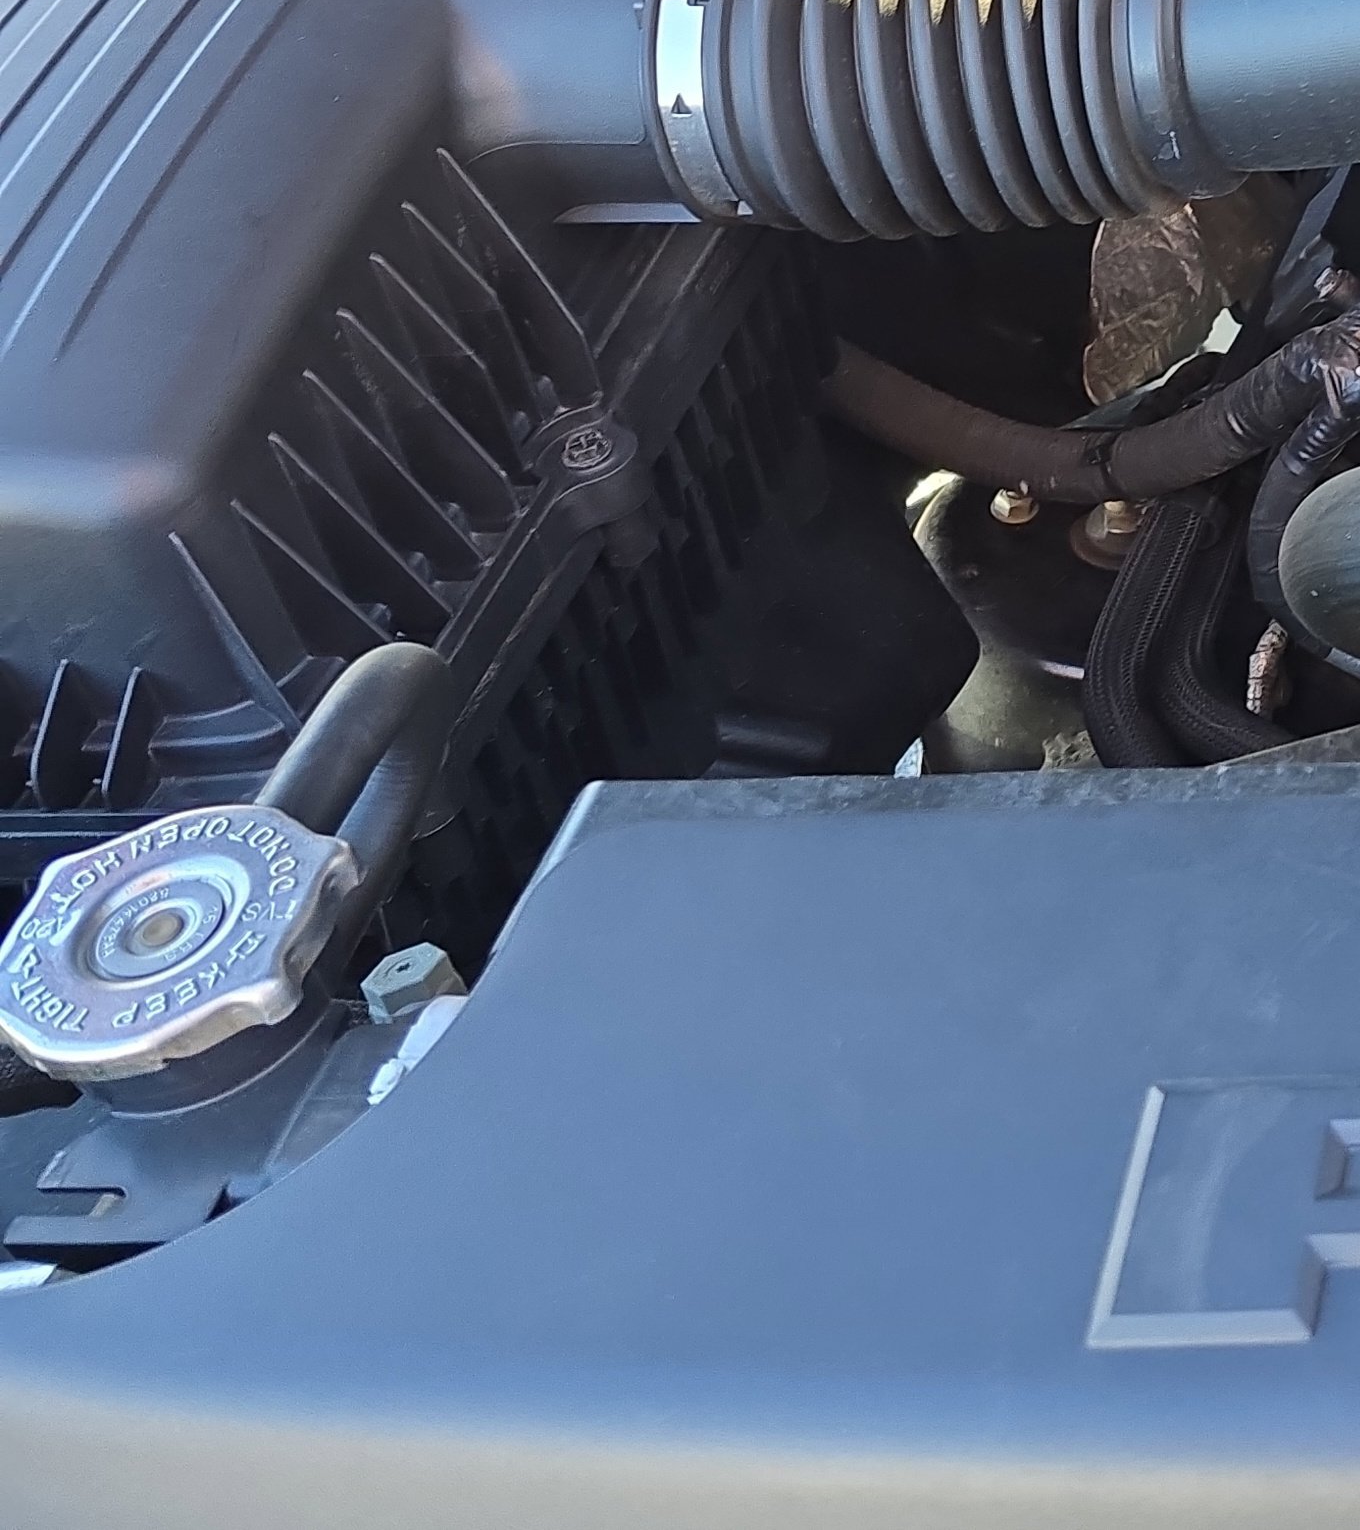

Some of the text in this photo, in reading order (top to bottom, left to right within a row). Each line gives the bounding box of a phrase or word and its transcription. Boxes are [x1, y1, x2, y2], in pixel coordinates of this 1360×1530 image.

[129, 815, 231, 861] OPEN
[50, 851, 123, 916] HOT
[10, 964, 227, 1033] KEEP TIGHT
